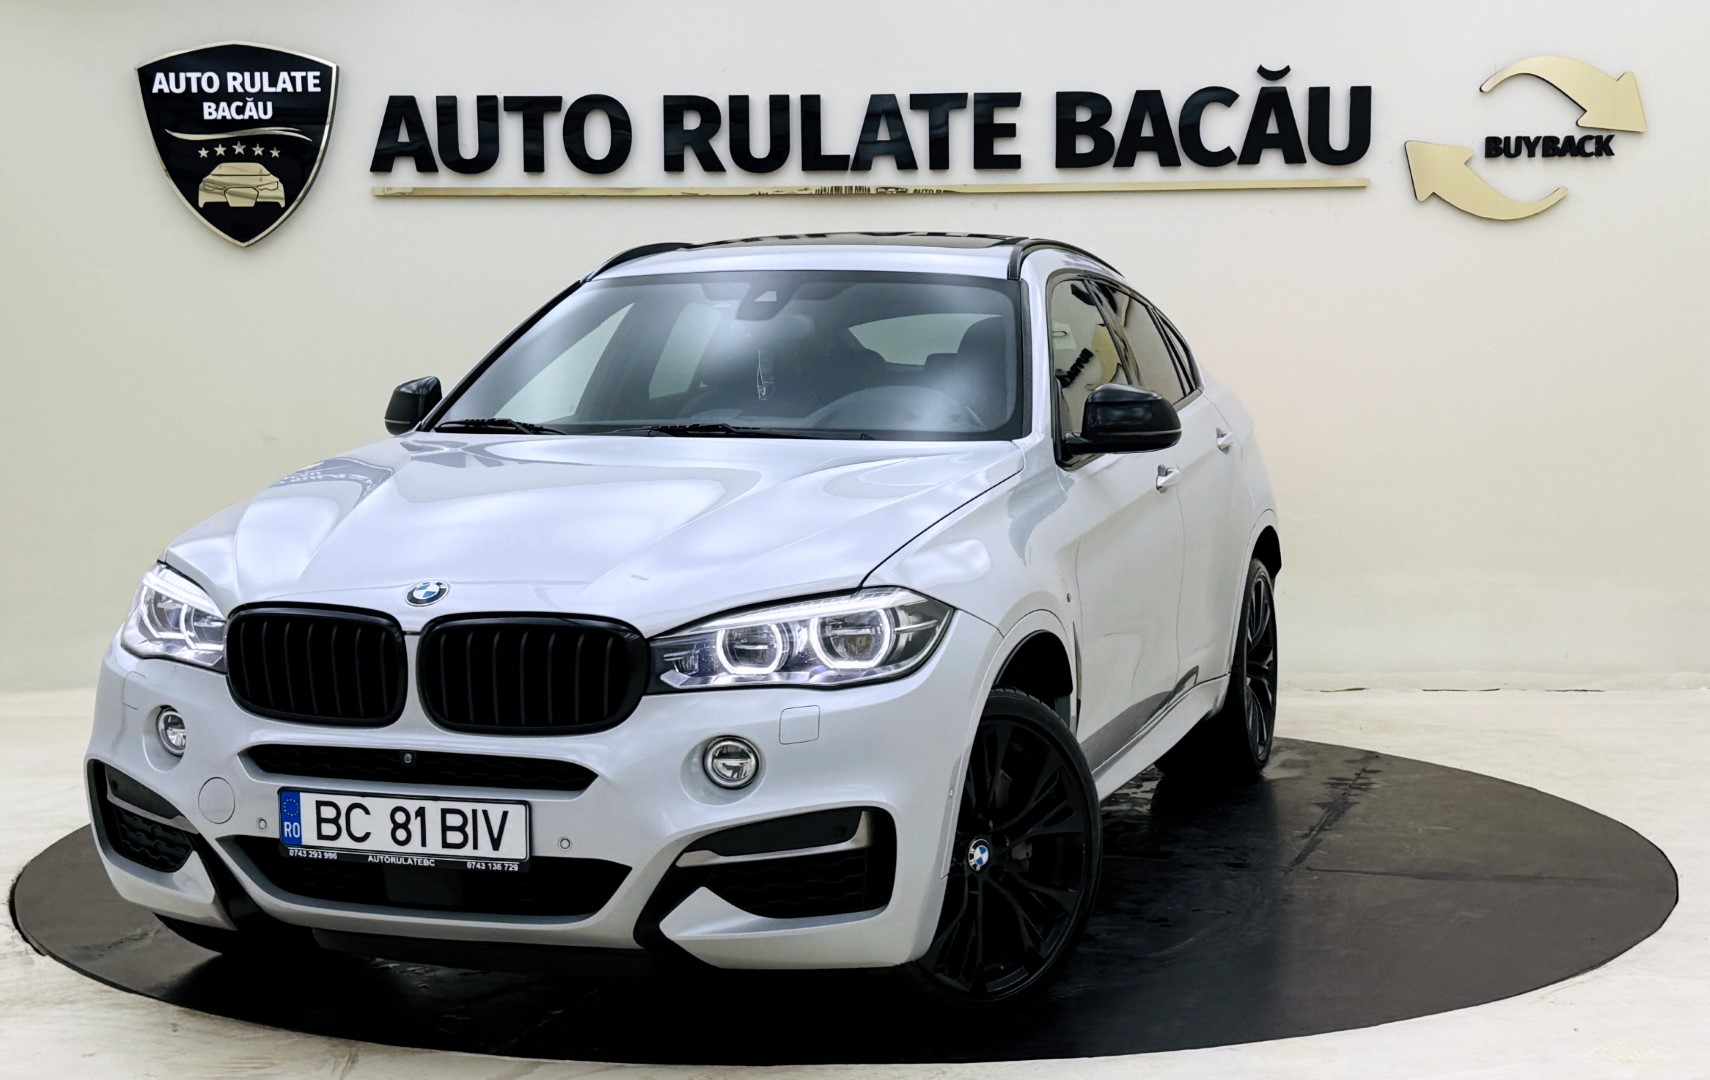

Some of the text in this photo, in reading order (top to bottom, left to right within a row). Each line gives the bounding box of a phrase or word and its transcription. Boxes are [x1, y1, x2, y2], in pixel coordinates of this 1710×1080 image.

[152, 71, 321, 93] AUTO RULATE
[203, 97, 273, 120] BACĂU
[370, 64, 1373, 174] AUTO RULATE BACĂU
[1484, 134, 1615, 159] BUYBACK
[284, 821, 300, 839] RO
[315, 800, 509, 852] BC 81 BIV
